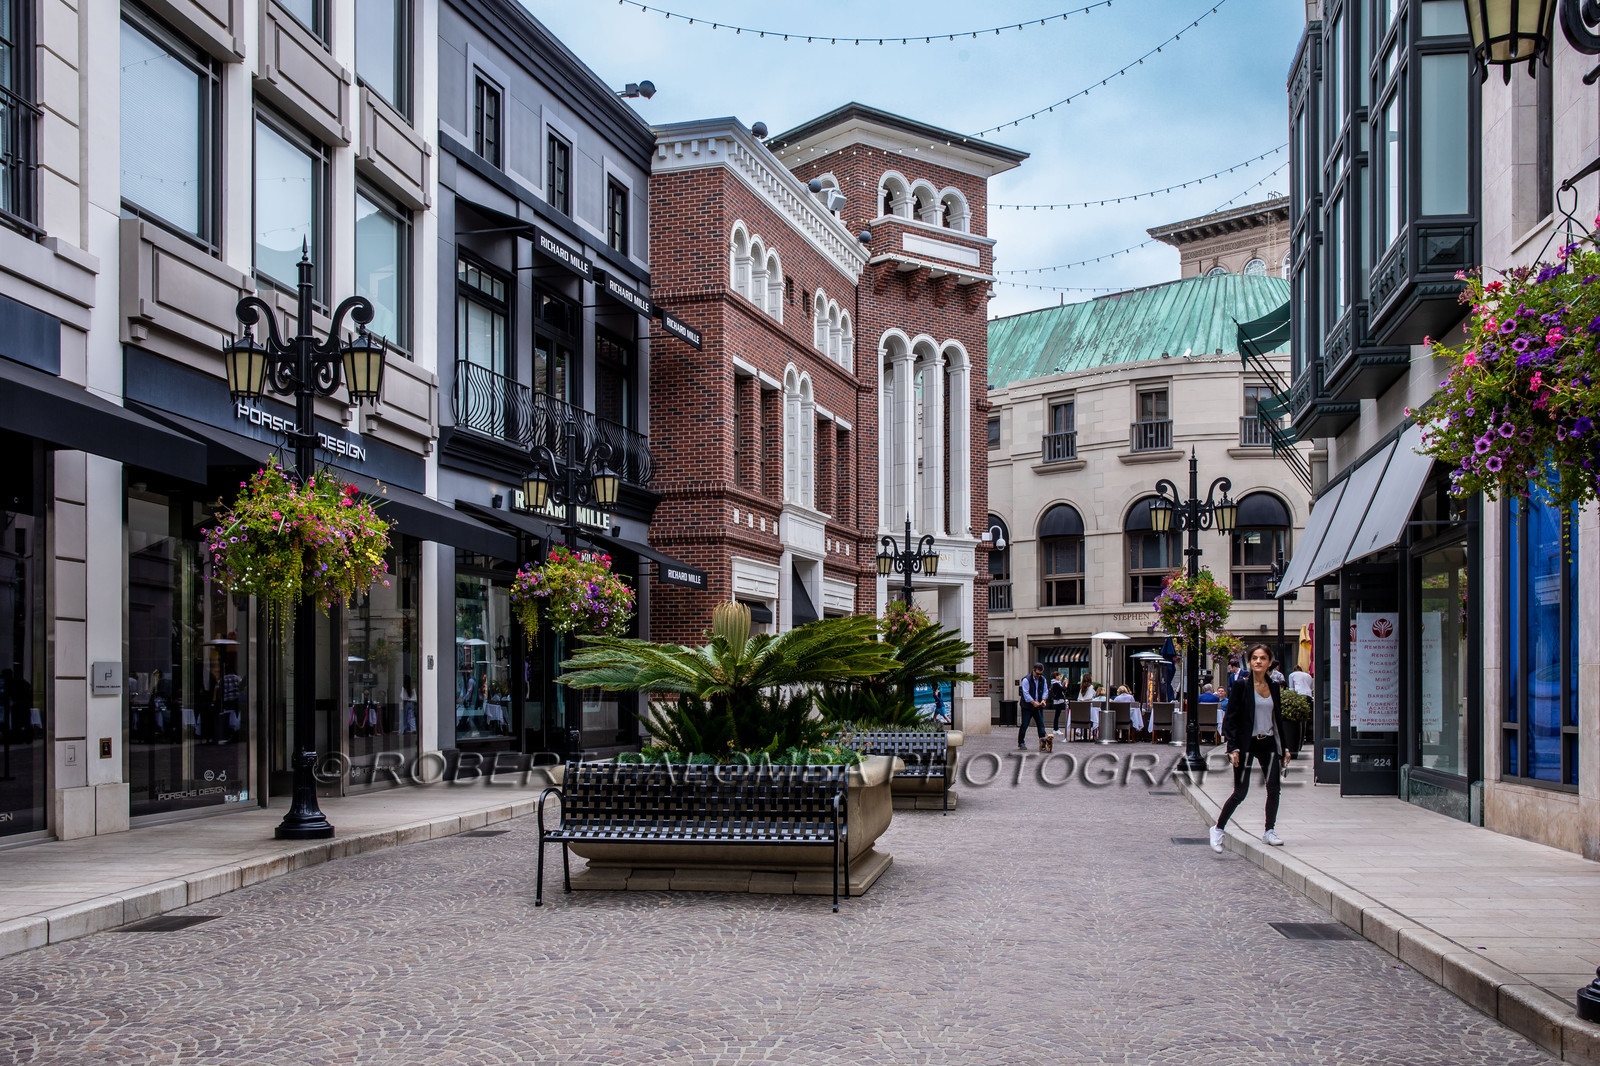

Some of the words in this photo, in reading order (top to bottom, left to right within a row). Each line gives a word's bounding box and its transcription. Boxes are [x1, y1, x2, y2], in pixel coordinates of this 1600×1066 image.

[540, 235, 569, 262] RICHARD
[570, 254, 589, 274] MILLE
[609, 279, 633, 303] RICHARD
[633, 295, 649, 313] MILLE
[666, 317, 687, 337] RICHARD
[687, 329, 700, 345] MILLE
[237, 402, 299, 432] PORSC
[317, 431, 367, 462] DESIGN
[576, 505, 610, 530] MILLE
[667, 569, 688, 582] RICHARD
[688, 573, 702, 585] MILLE
[1113, 613, 1150, 621] STEPHEN
[1373, 758, 1391, 767] 224
[158, 789, 197, 801] PORSCHE
[198, 785, 227, 796] DESIGN
